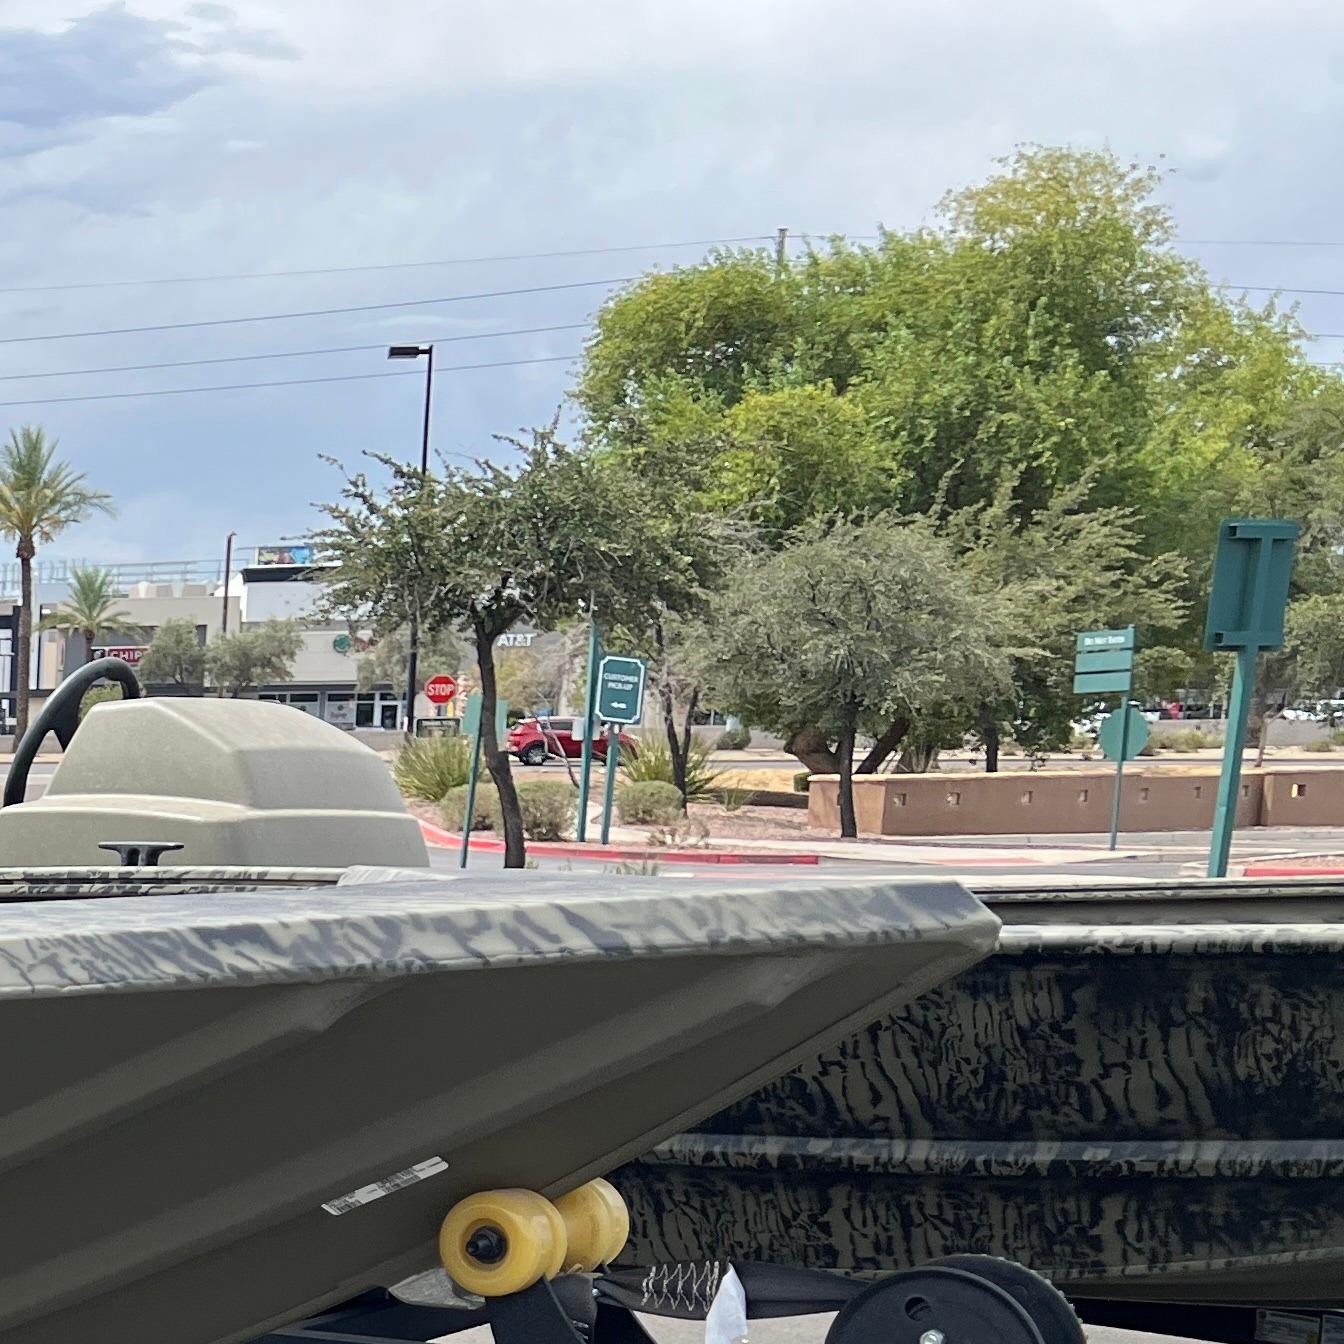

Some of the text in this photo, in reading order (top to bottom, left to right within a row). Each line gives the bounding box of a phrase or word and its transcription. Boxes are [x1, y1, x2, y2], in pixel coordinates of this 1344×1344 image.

[496, 633, 537, 647] AT&T
[604, 672, 639, 683] CUSTOMER
[428, 684, 455, 696] STOP
